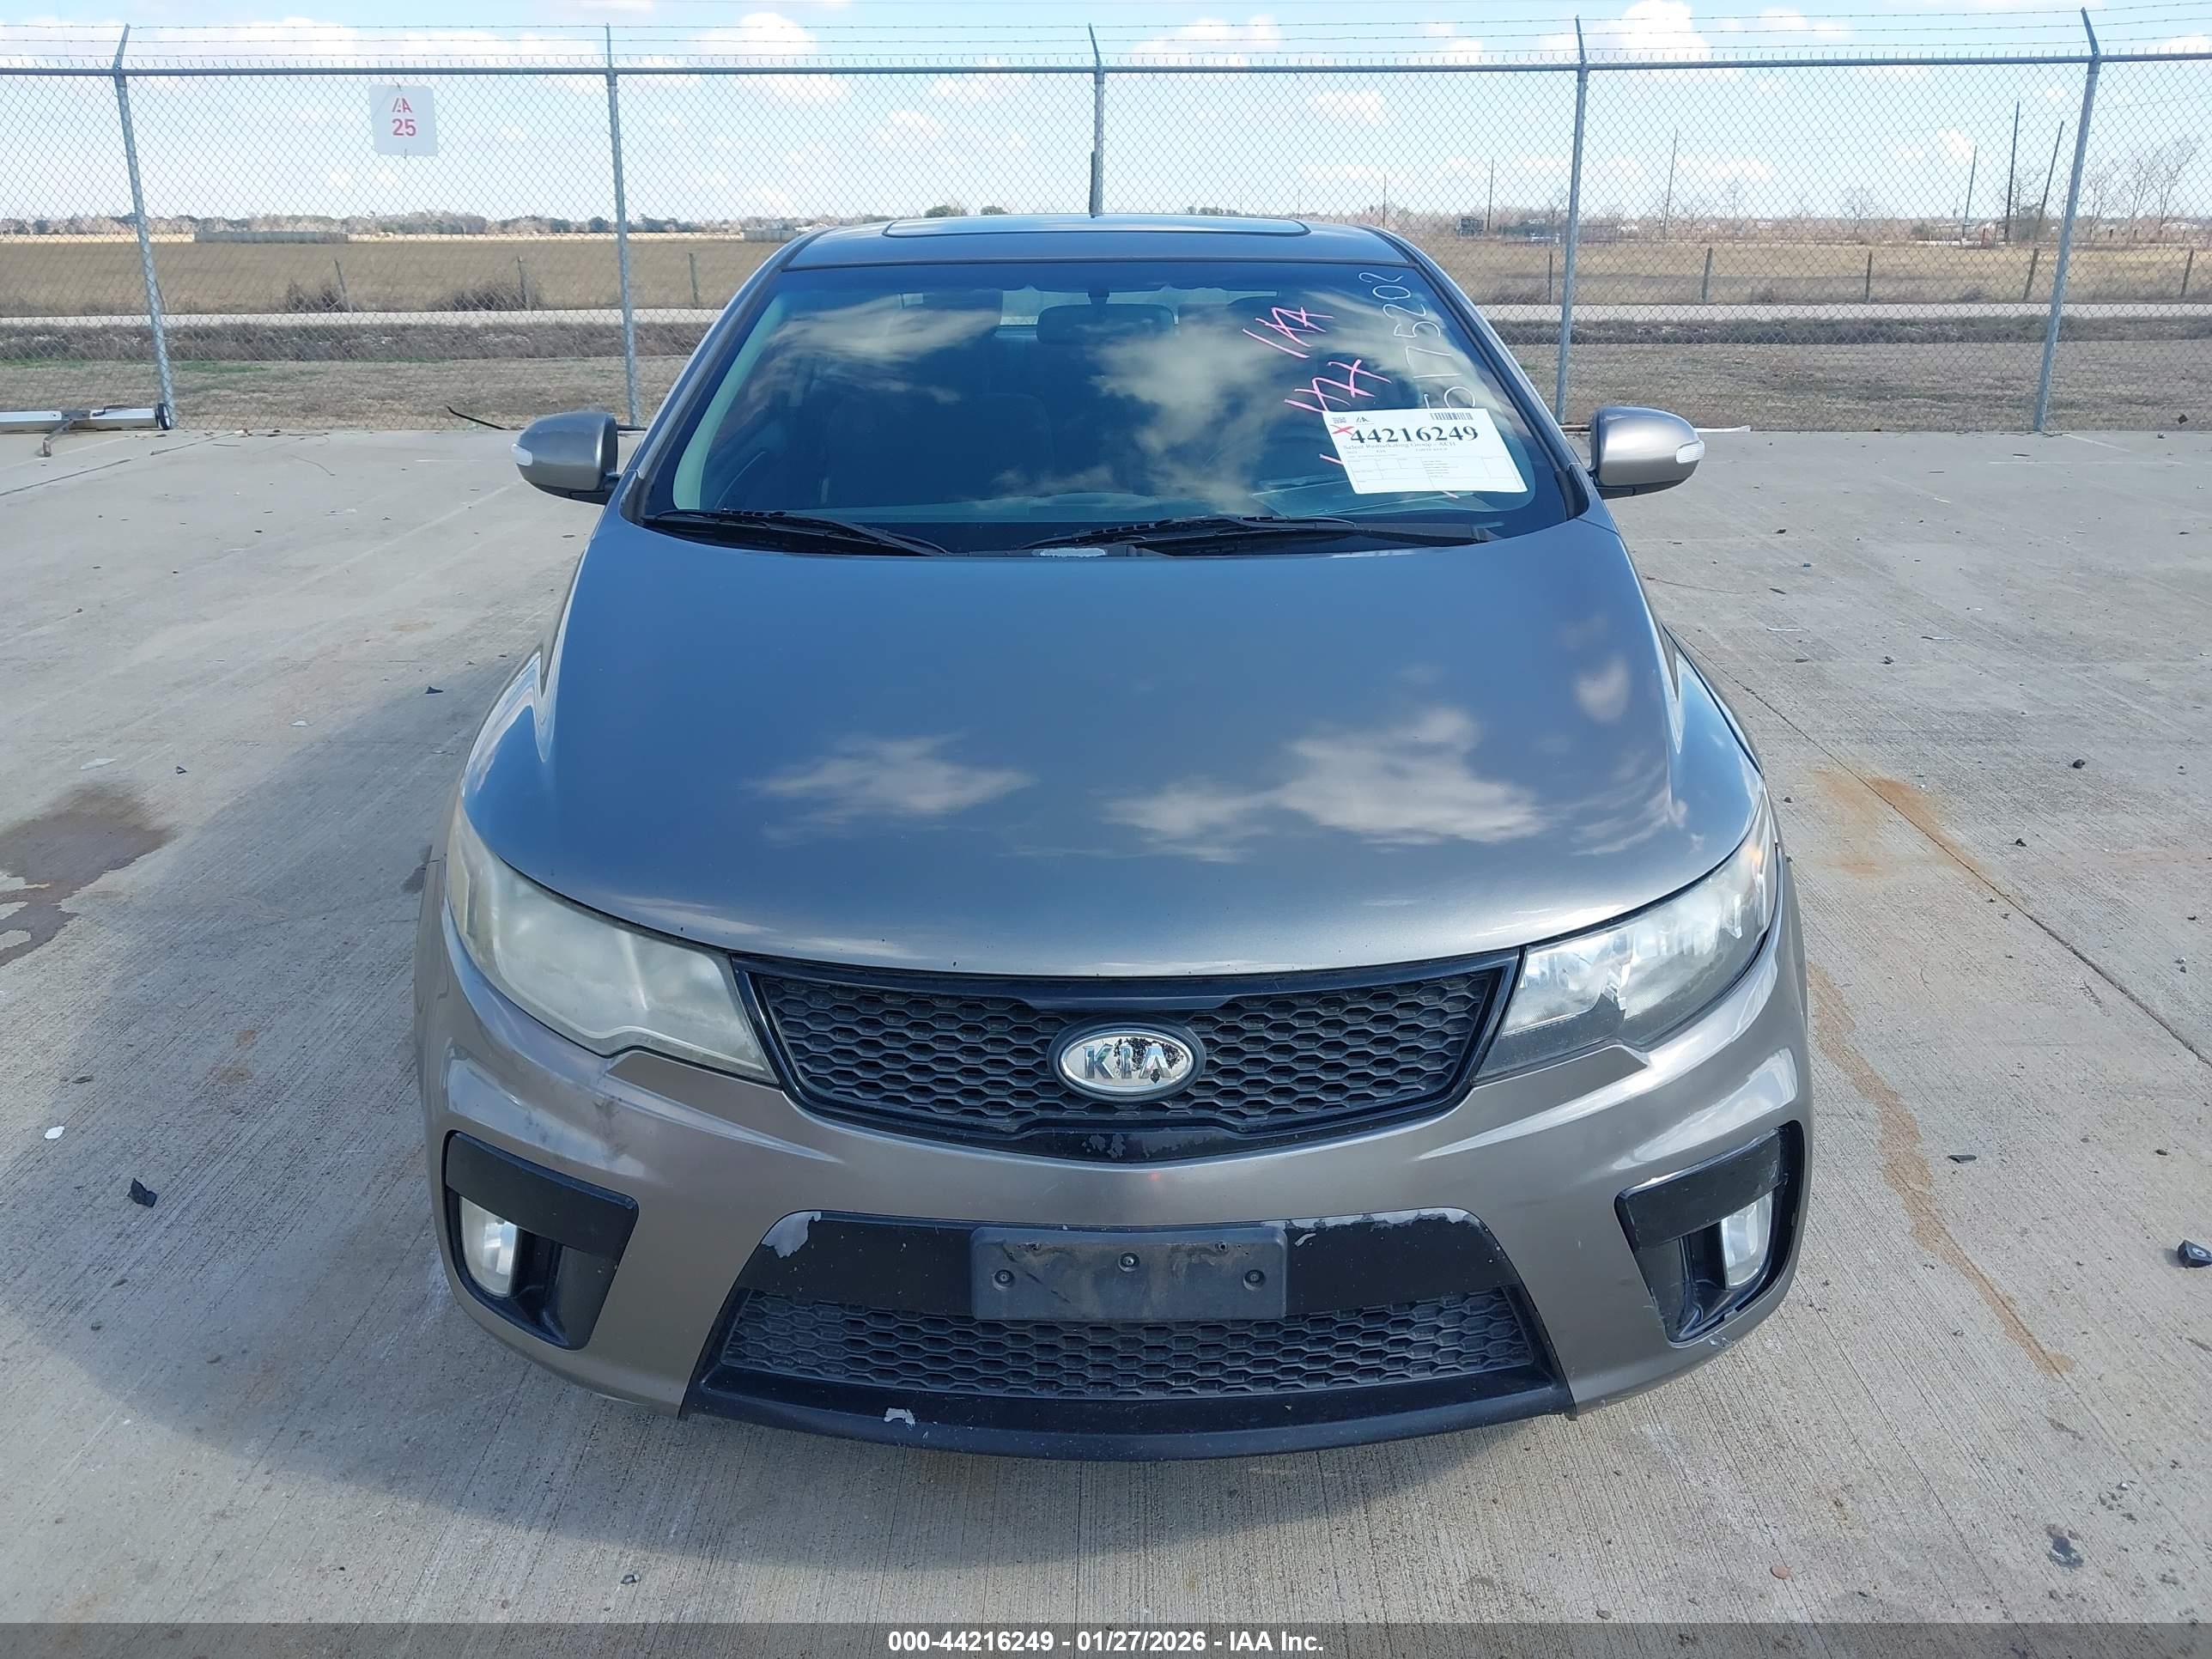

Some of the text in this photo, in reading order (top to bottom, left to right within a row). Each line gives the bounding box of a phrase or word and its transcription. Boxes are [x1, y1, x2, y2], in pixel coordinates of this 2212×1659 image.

[392, 118, 416, 137] 25
[1351, 426, 1478, 443] 44216249
[1083, 1043, 1172, 1079] KIA
